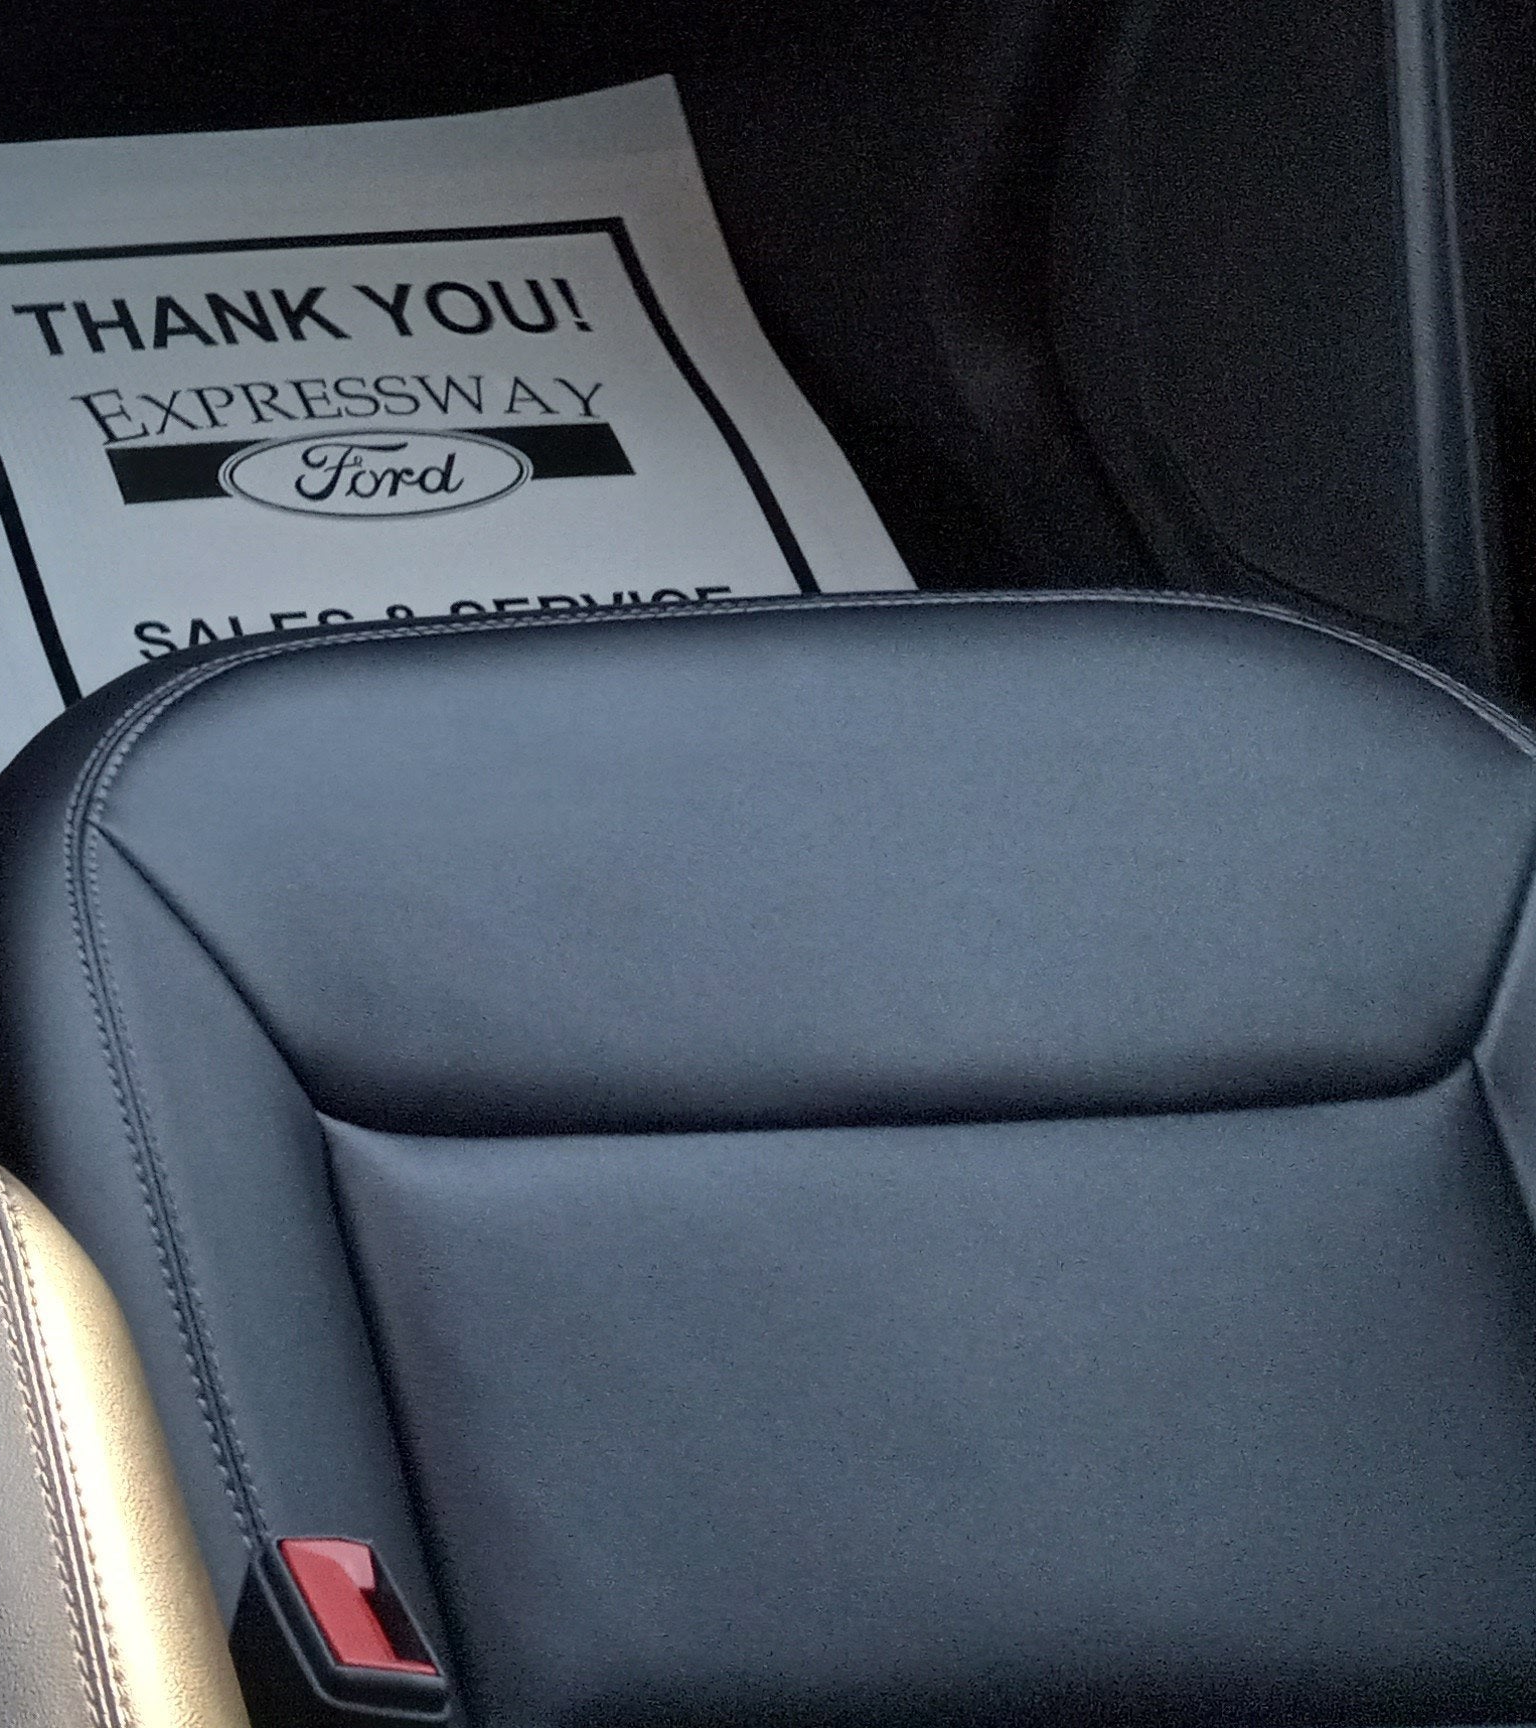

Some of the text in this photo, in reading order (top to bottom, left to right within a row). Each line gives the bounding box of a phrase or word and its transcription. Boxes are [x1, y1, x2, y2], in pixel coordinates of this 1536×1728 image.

[11, 278, 594, 355] THANK YOU!
[70, 375, 603, 445] EXPRESSWAY
[295, 442, 464, 502] Ford
